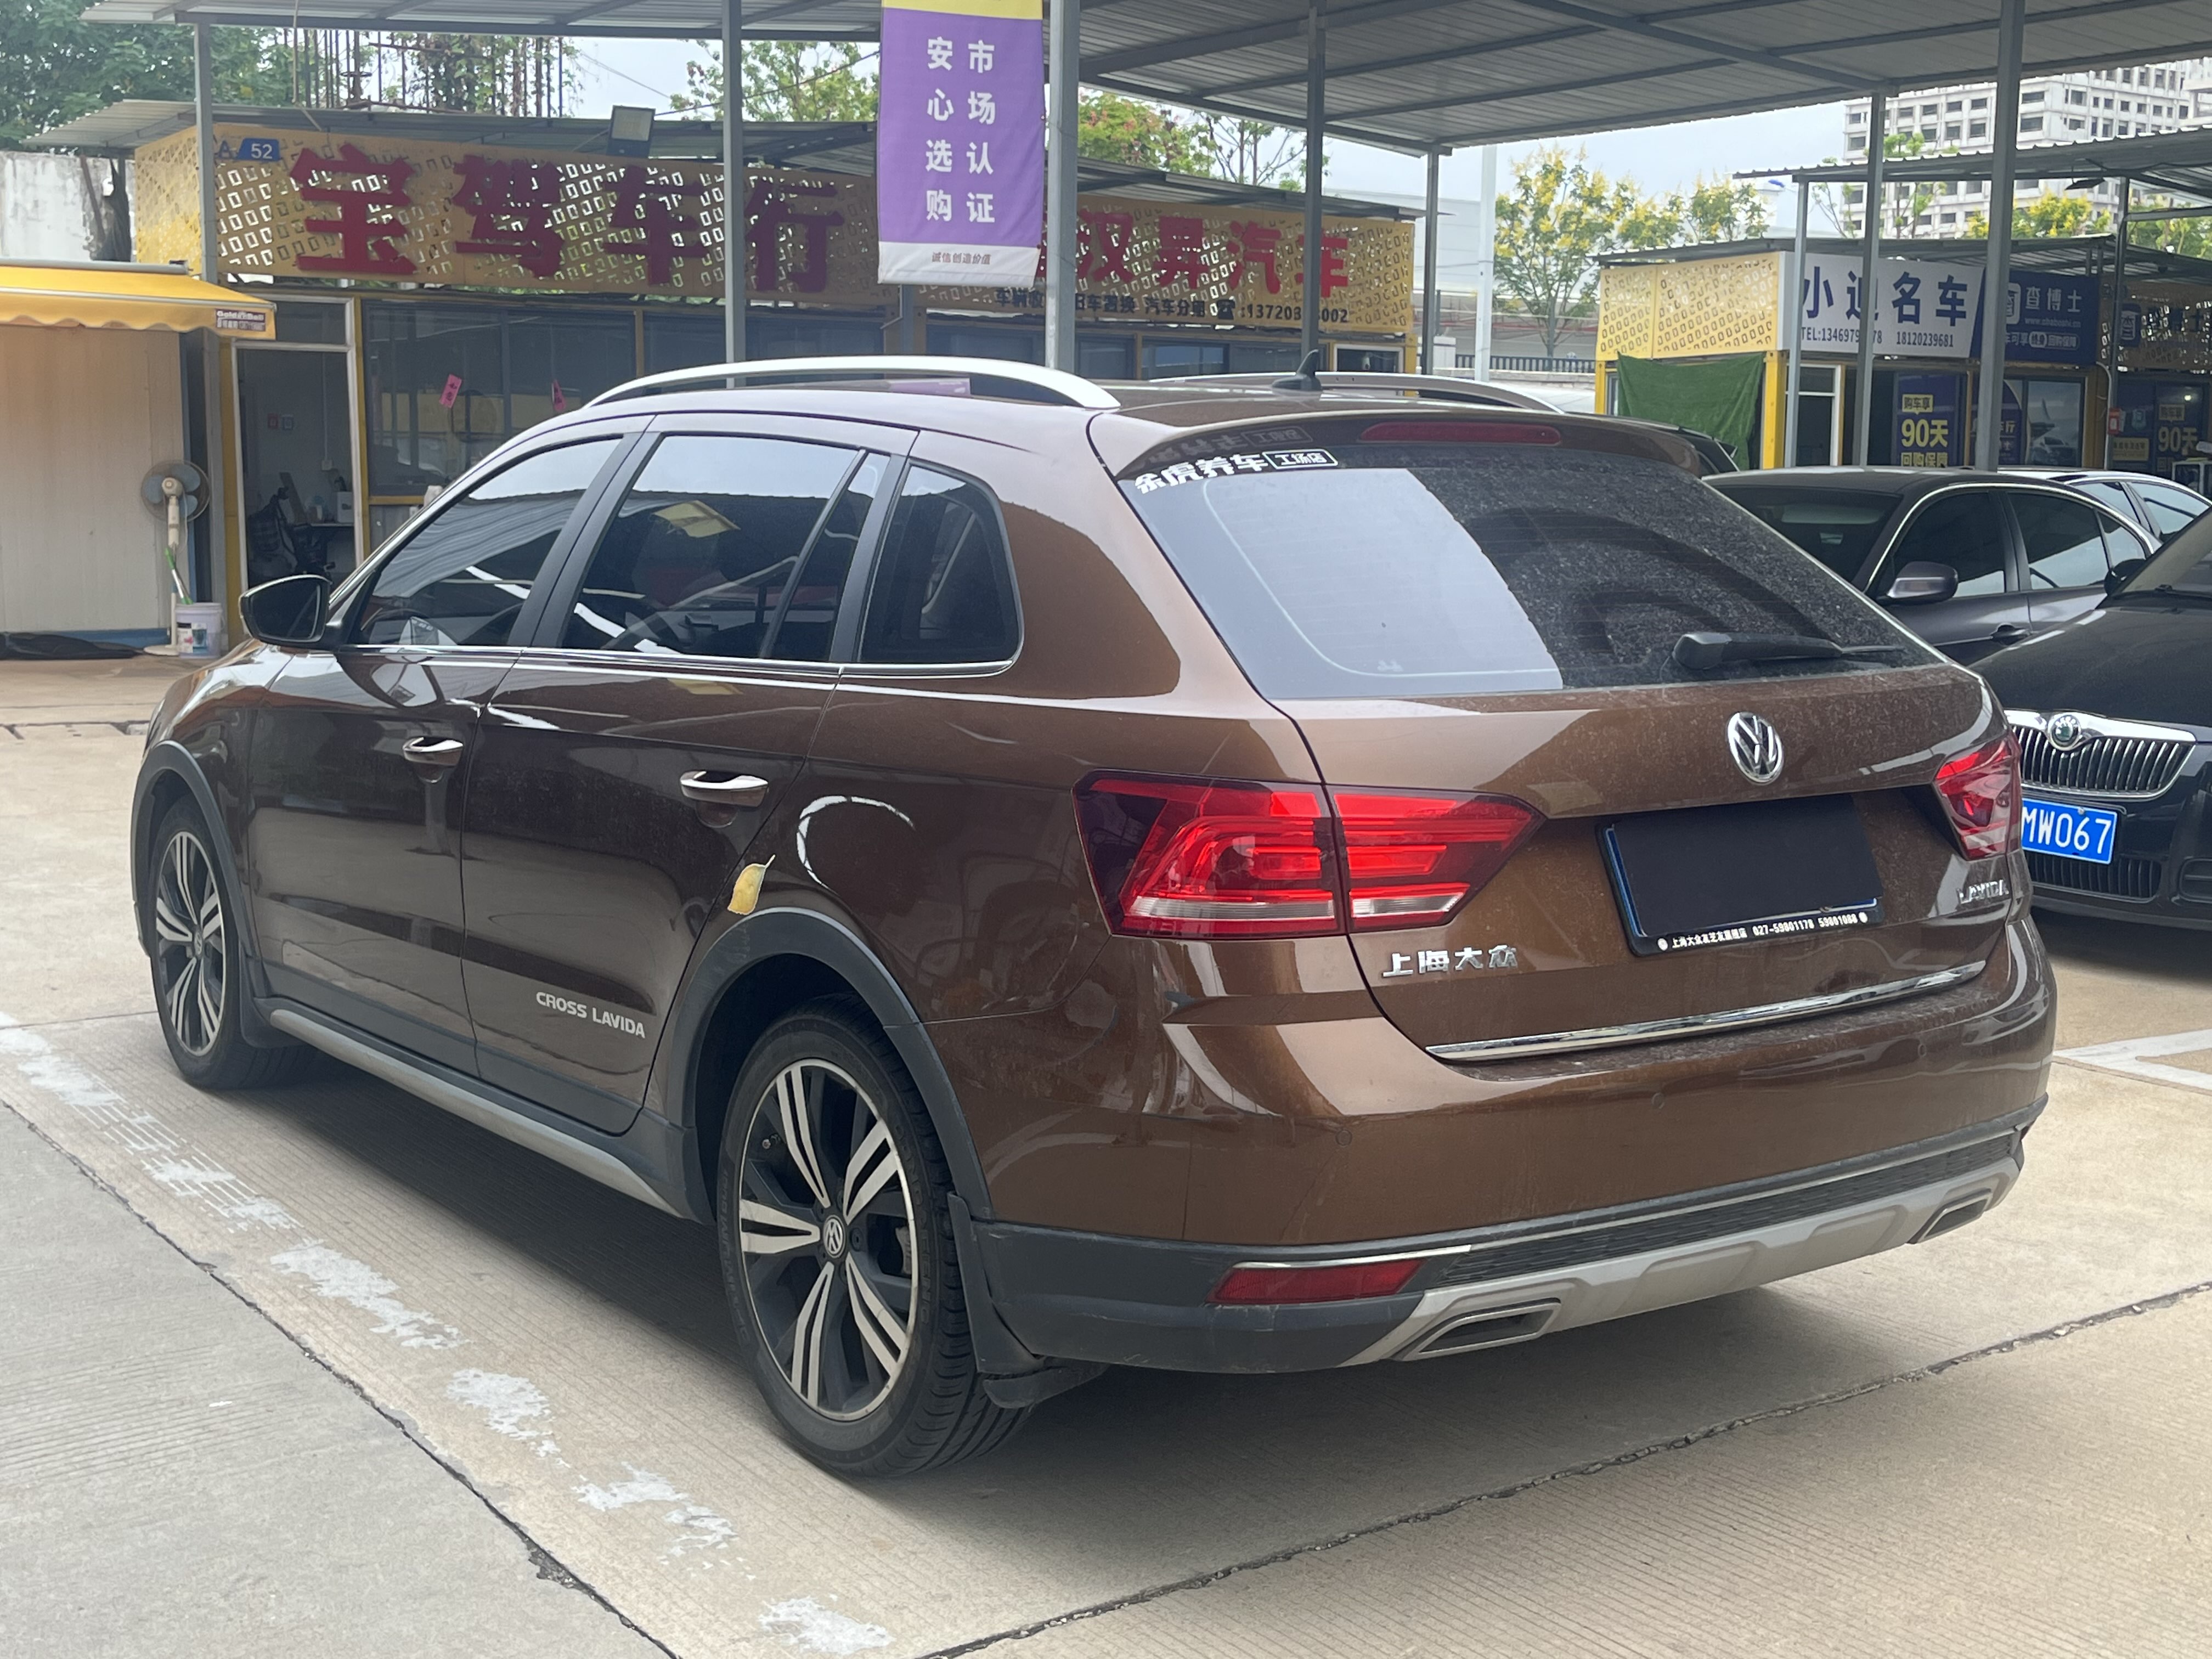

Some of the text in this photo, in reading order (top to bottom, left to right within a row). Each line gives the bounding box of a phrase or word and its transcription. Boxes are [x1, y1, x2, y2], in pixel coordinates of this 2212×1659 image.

[926, 36, 954, 222] 安心选购
[967, 40, 996, 223] 市场认证
[251, 143, 273, 159] 52
[2025, 286, 2082, 312] 查博士
[1802, 327, 1953, 347] TEL:134697978 18120239681
[1901, 419, 1948, 447] 90天
[1383, 945, 1518, 978] 上海大众
[536, 992, 646, 1039] CROSS LAVIDA
